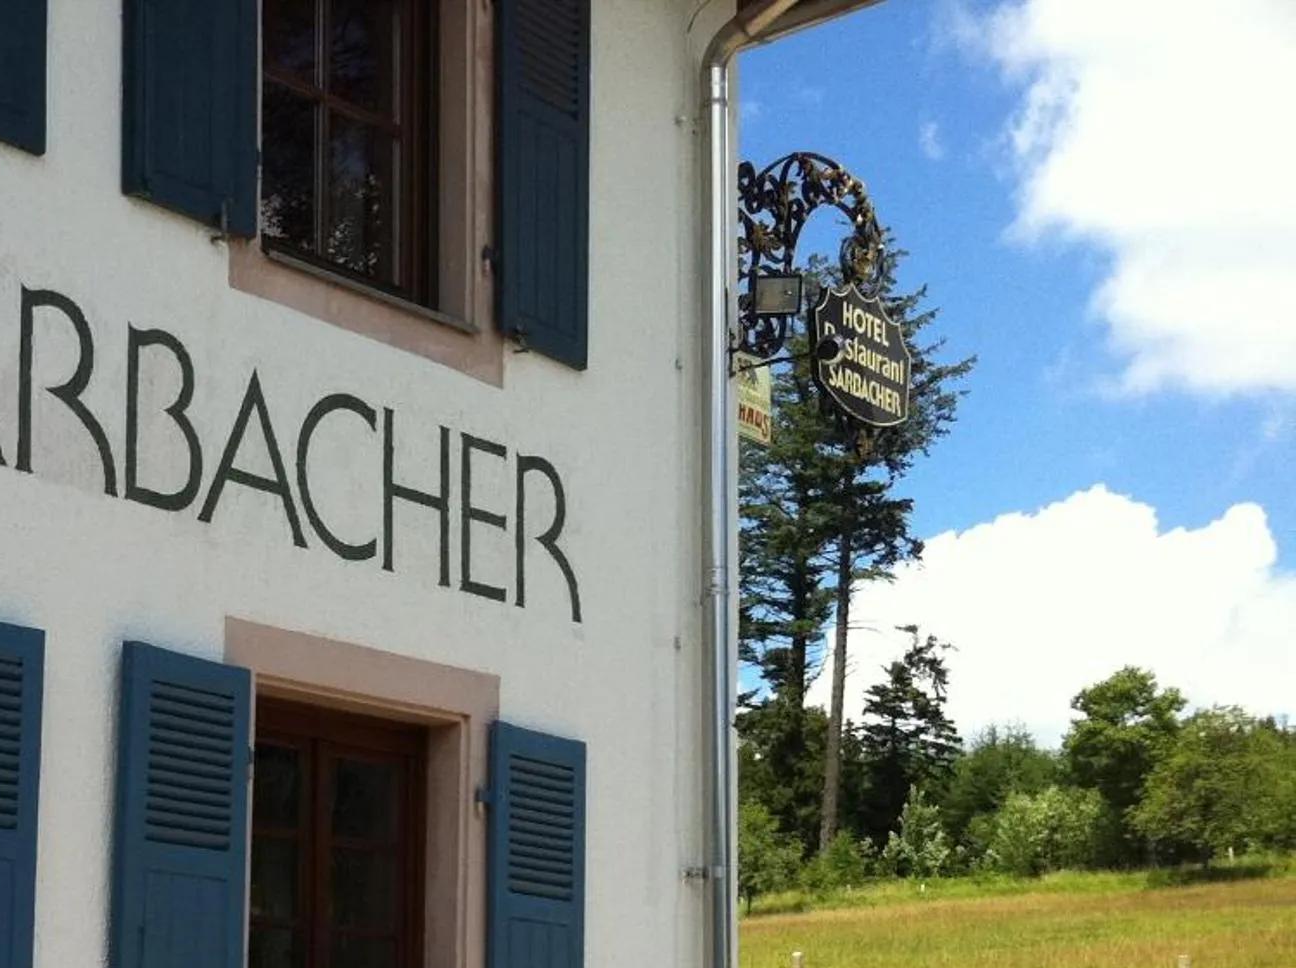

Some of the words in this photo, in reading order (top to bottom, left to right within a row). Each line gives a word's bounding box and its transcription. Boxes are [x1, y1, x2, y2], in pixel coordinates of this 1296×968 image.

[842, 301, 889, 346] HOTEL
[825, 322, 904, 384] Rstaurant
[828, 364, 902, 417] SARBACHER
